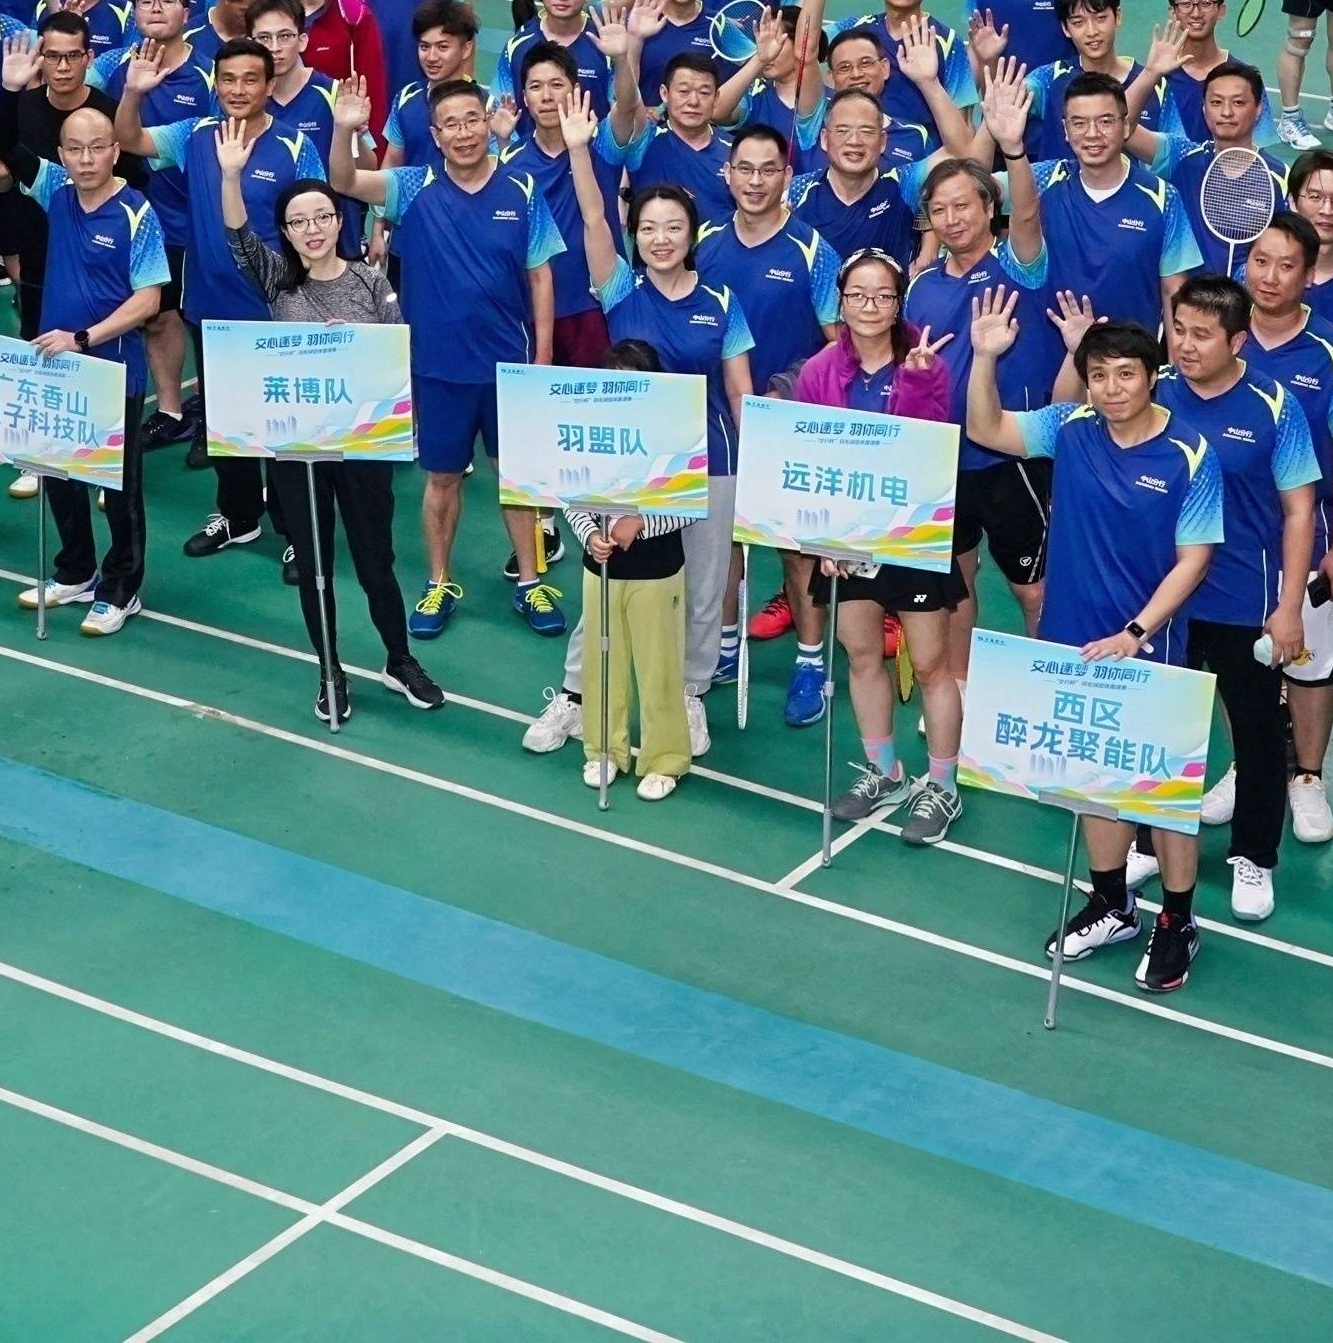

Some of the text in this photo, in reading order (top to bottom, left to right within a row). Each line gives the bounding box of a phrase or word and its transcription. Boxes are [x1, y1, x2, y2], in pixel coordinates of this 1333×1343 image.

[255, 169, 275, 178] 中山分行
[1122, 218, 1144, 227] 中山分行
[95, 235, 114, 244] 中山分行
[770, 269, 791, 278] 中山分行
[1295, 375, 1319, 385] 中山分行
[263, 376, 353, 405] 莱博队
[794, 420, 902, 438] 交心逐梦 羽你同行
[1228, 427, 1253, 438] 中山分行
[557, 424, 648, 457] 羽盟队
[781, 460, 908, 507] 远洋机电
[1141, 475, 1166, 487] 中山分行
[1030, 659, 1152, 684] 交心逐梦 羽你同行
[1053, 690, 1123, 732] 西区
[995, 712, 1172, 780] 醉龙聚能队
